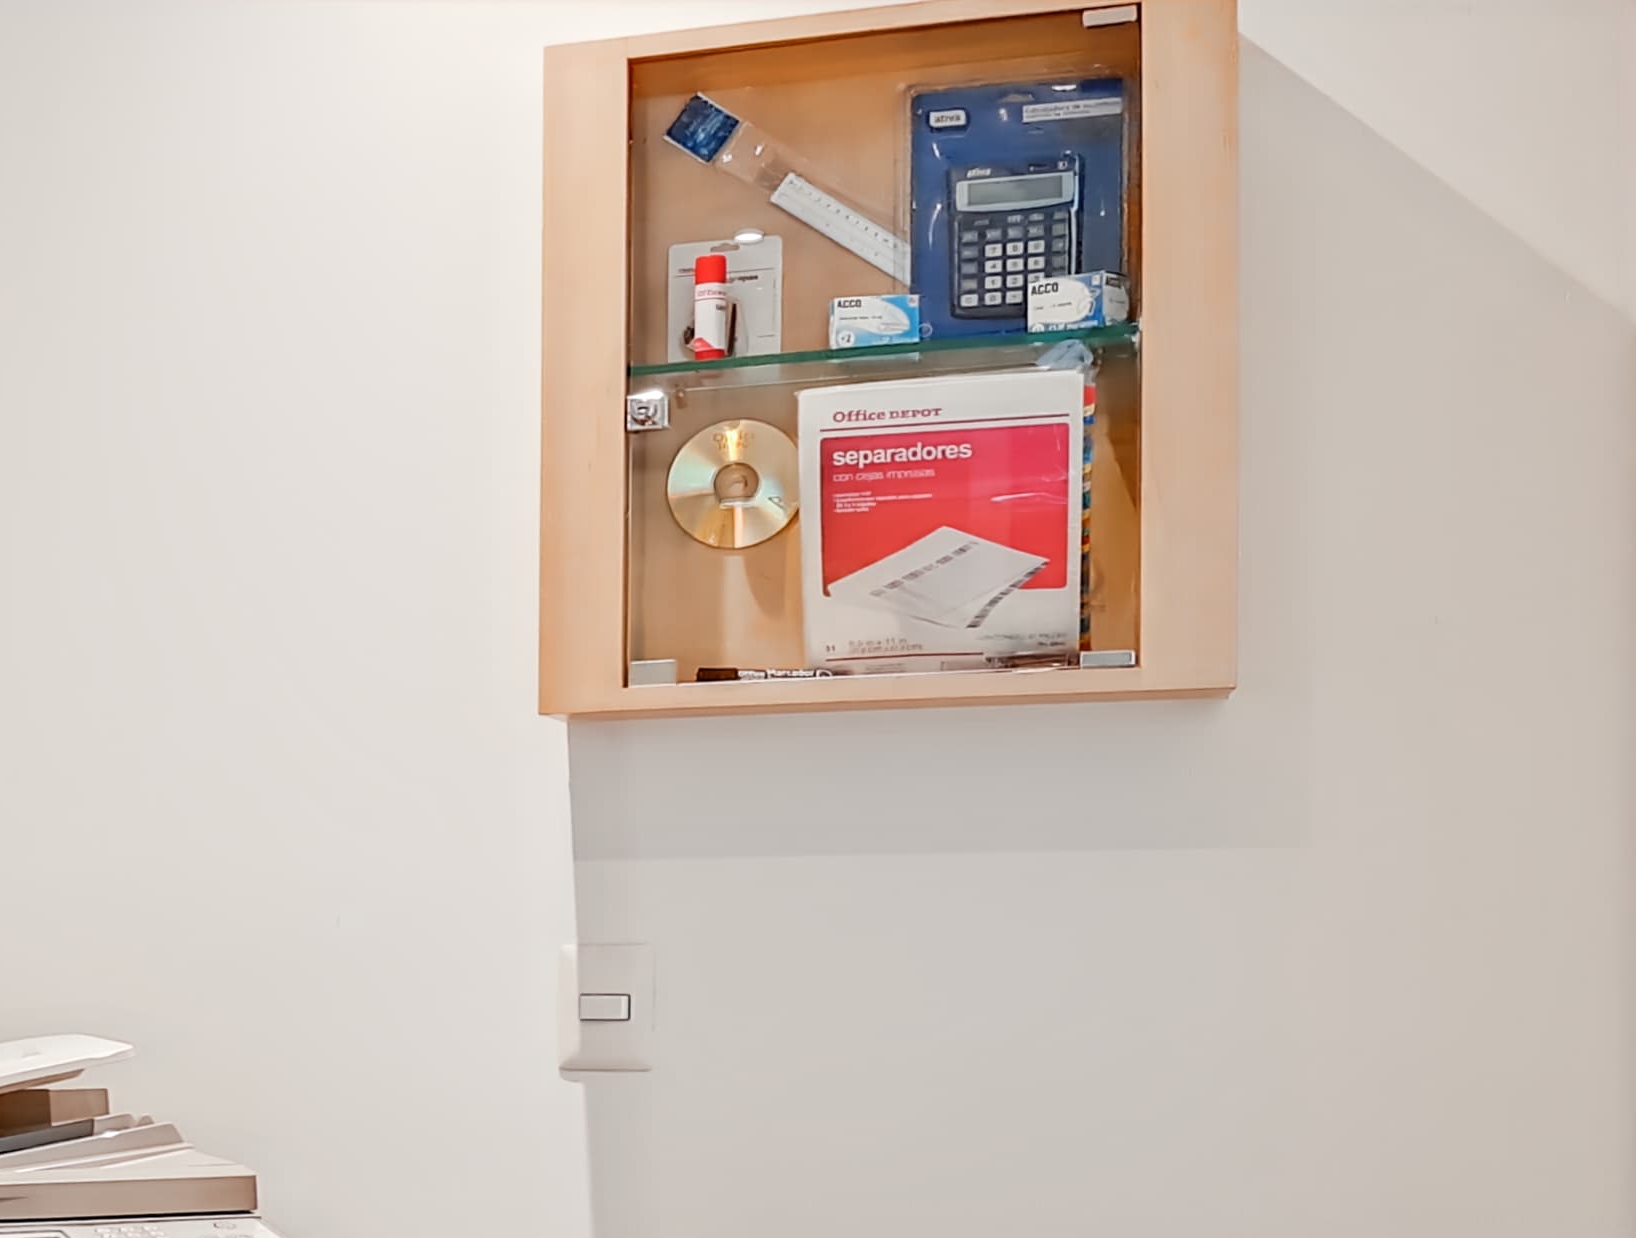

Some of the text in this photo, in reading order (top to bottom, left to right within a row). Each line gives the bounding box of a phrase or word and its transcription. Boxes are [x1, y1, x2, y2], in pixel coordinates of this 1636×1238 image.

[1031, 282, 1059, 296] ACCO
[837, 299, 862, 308] ACCO
[832, 407, 942, 424] Office DEPOT
[832, 441, 973, 470] separadores
